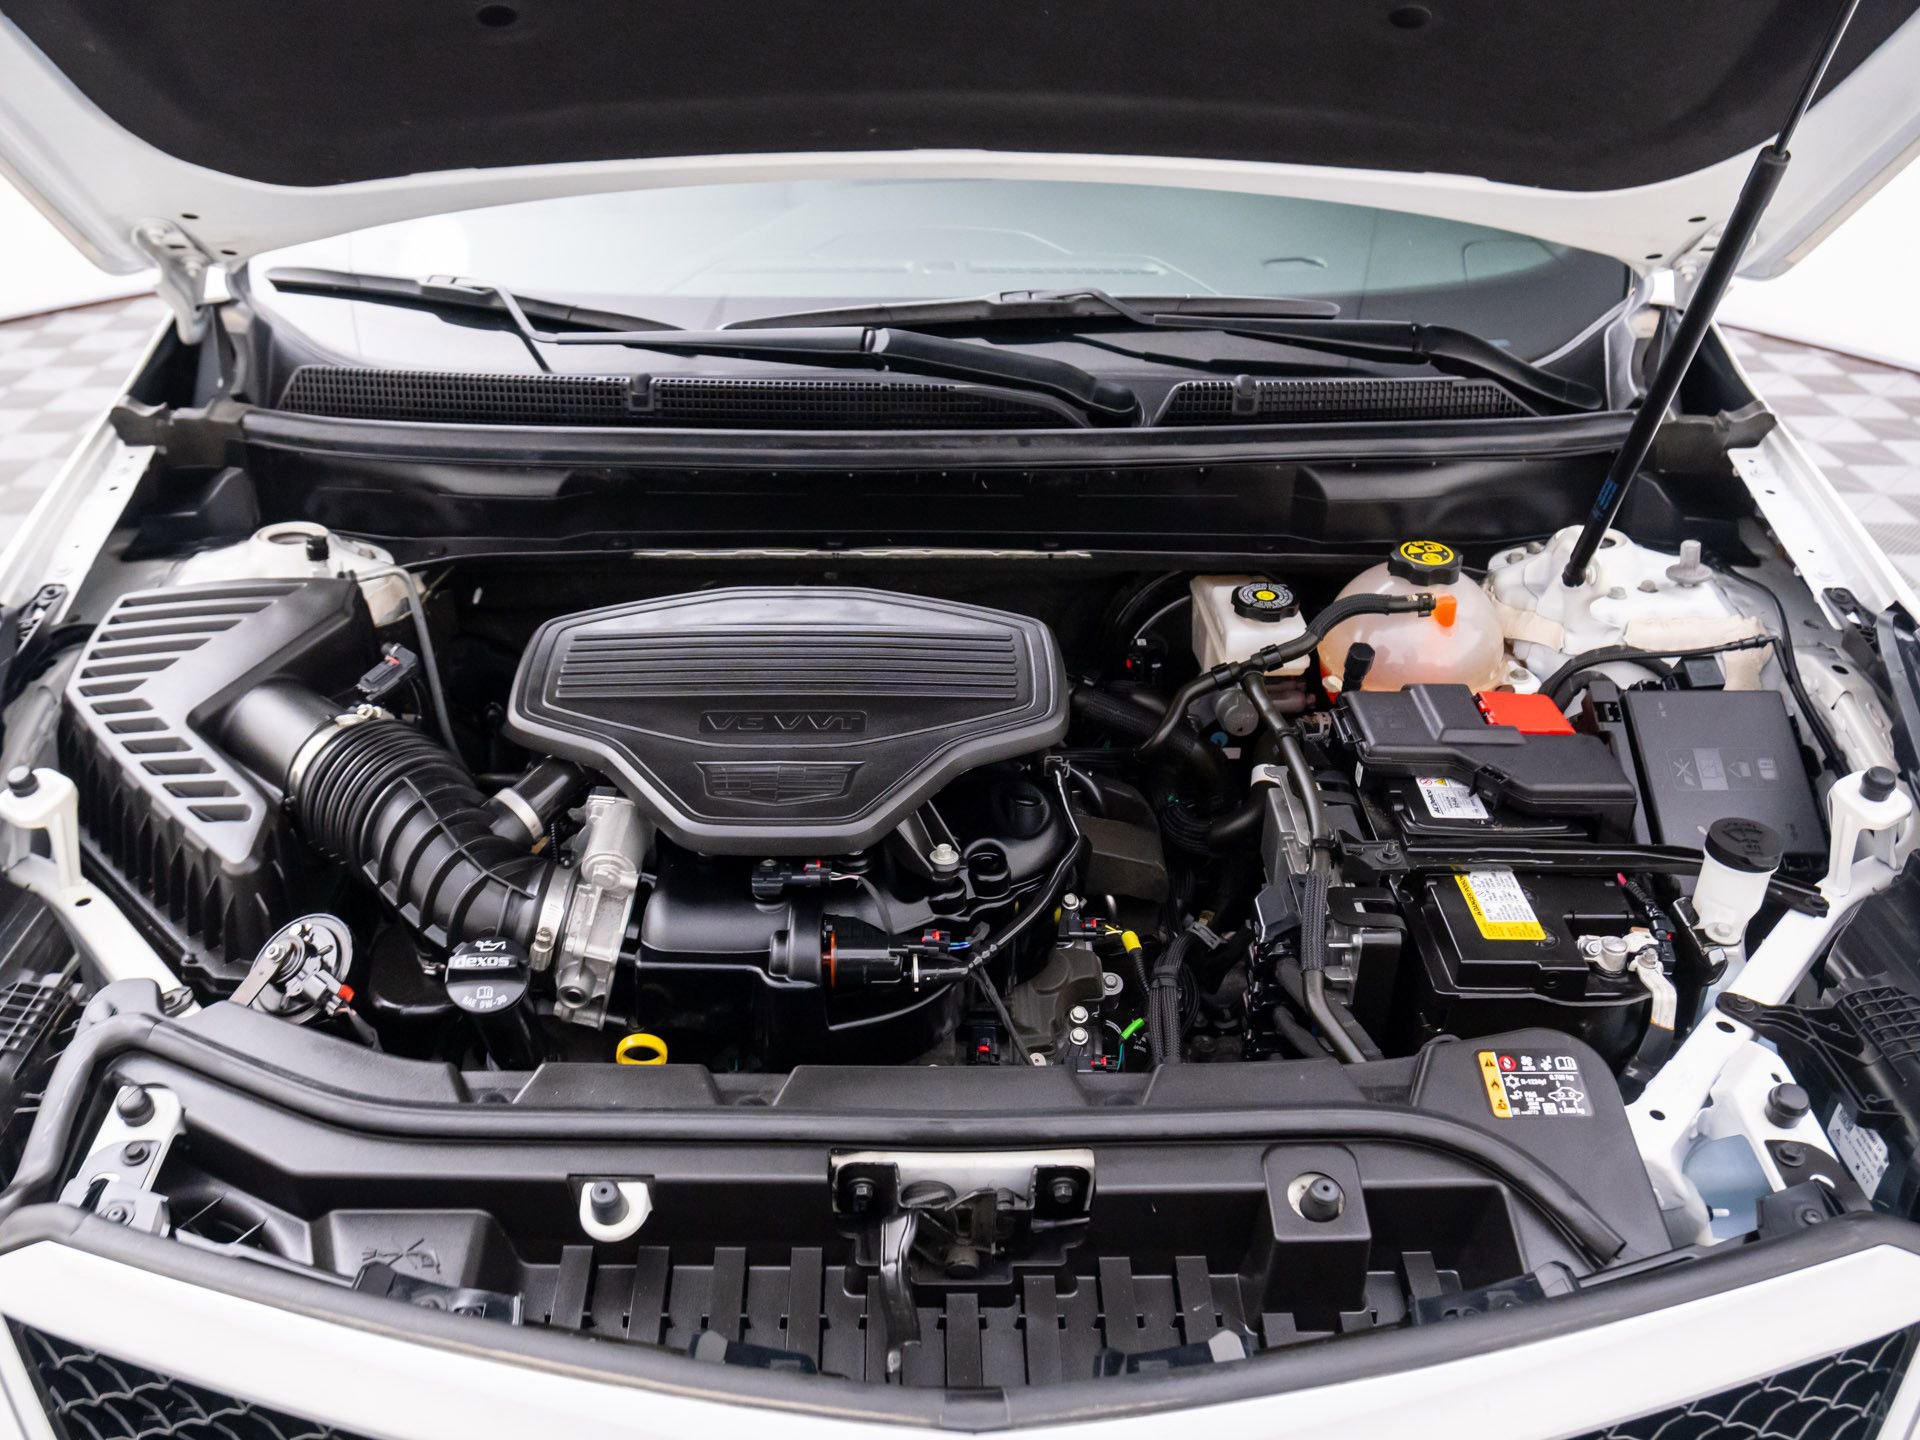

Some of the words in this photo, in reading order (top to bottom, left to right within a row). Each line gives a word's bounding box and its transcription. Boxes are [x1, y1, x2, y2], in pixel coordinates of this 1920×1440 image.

[706, 714, 764, 730] V6
[773, 714, 862, 730] VVT
[454, 954, 510, 969] dexos
